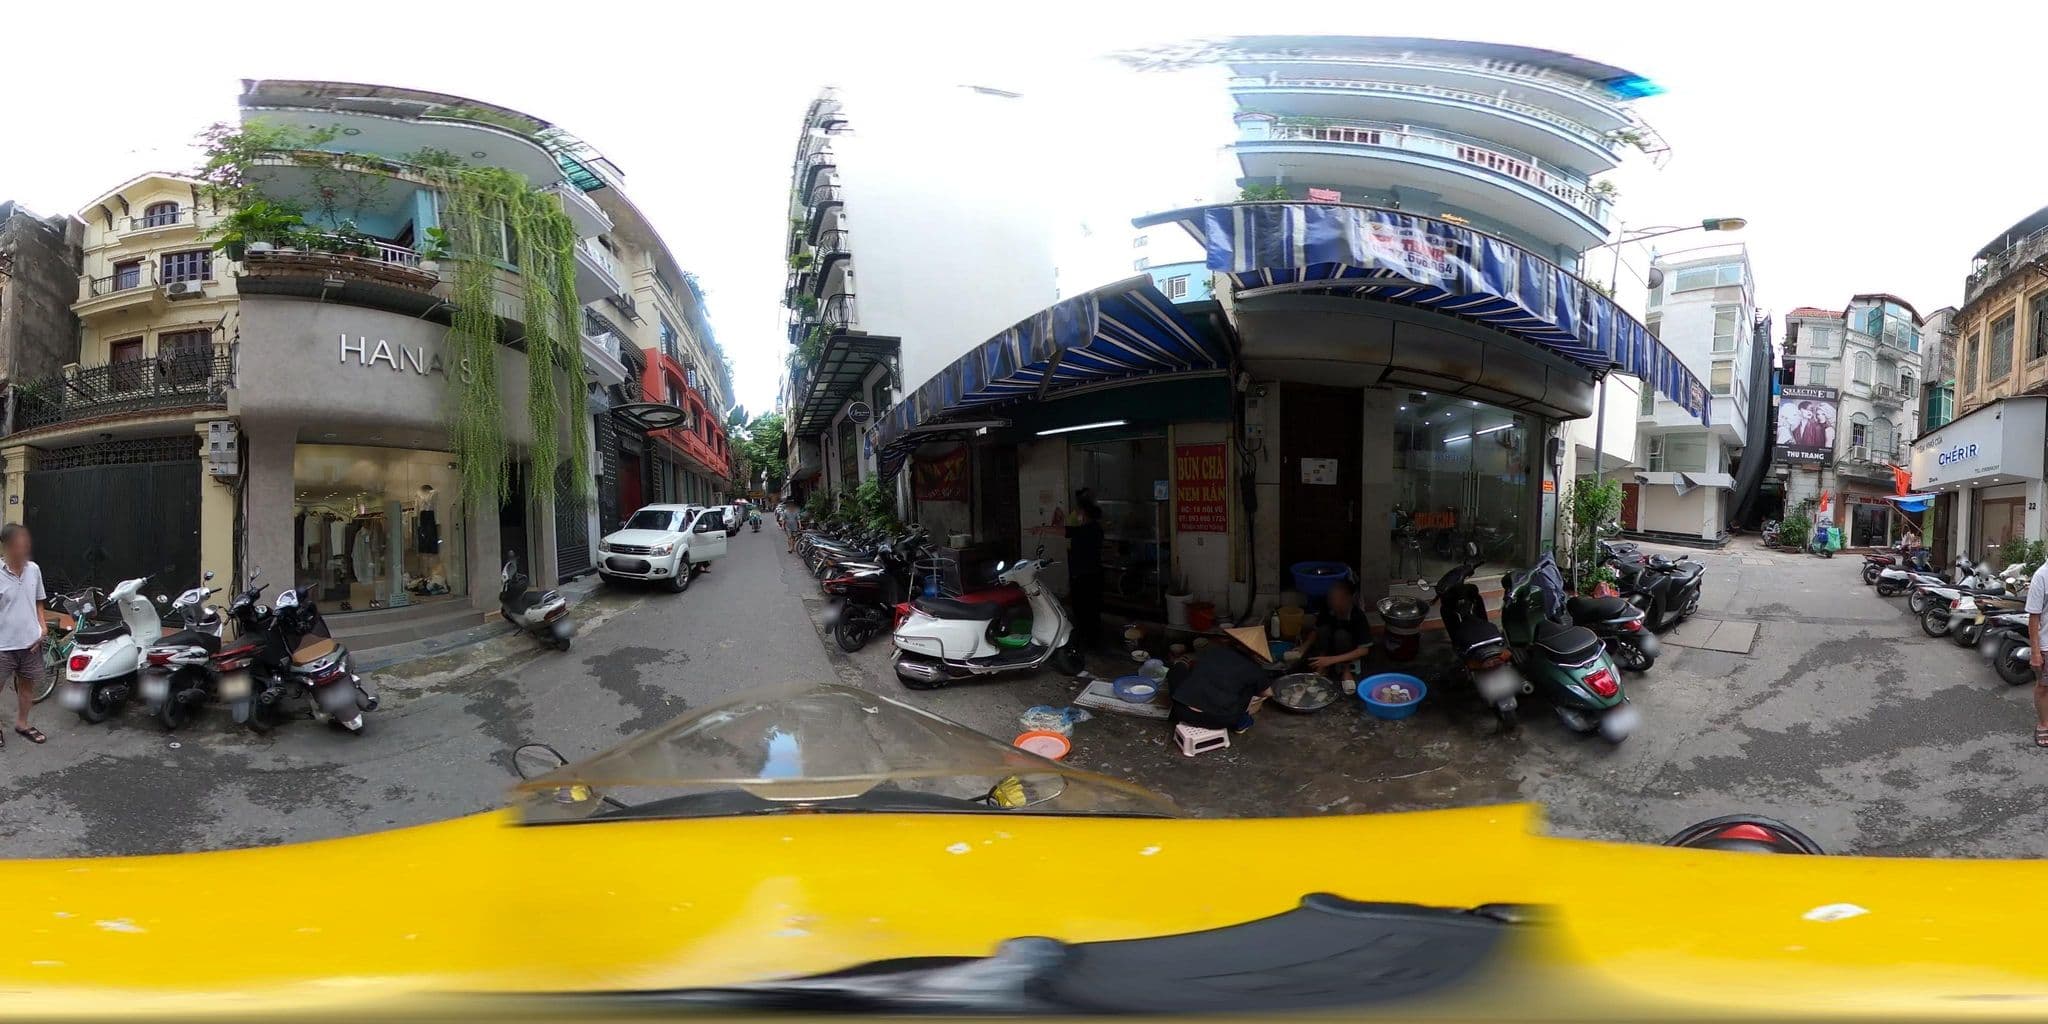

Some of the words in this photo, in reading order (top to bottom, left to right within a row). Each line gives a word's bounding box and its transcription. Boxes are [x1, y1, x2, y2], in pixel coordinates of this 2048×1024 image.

[340, 334, 472, 384] HANAS
[1783, 388, 1825, 398] SELECTIVE
[1178, 450, 1200, 480] BÚN
[1801, 452, 1825, 460] TRANG
[1938, 444, 1978, 466] CHÉRIR
